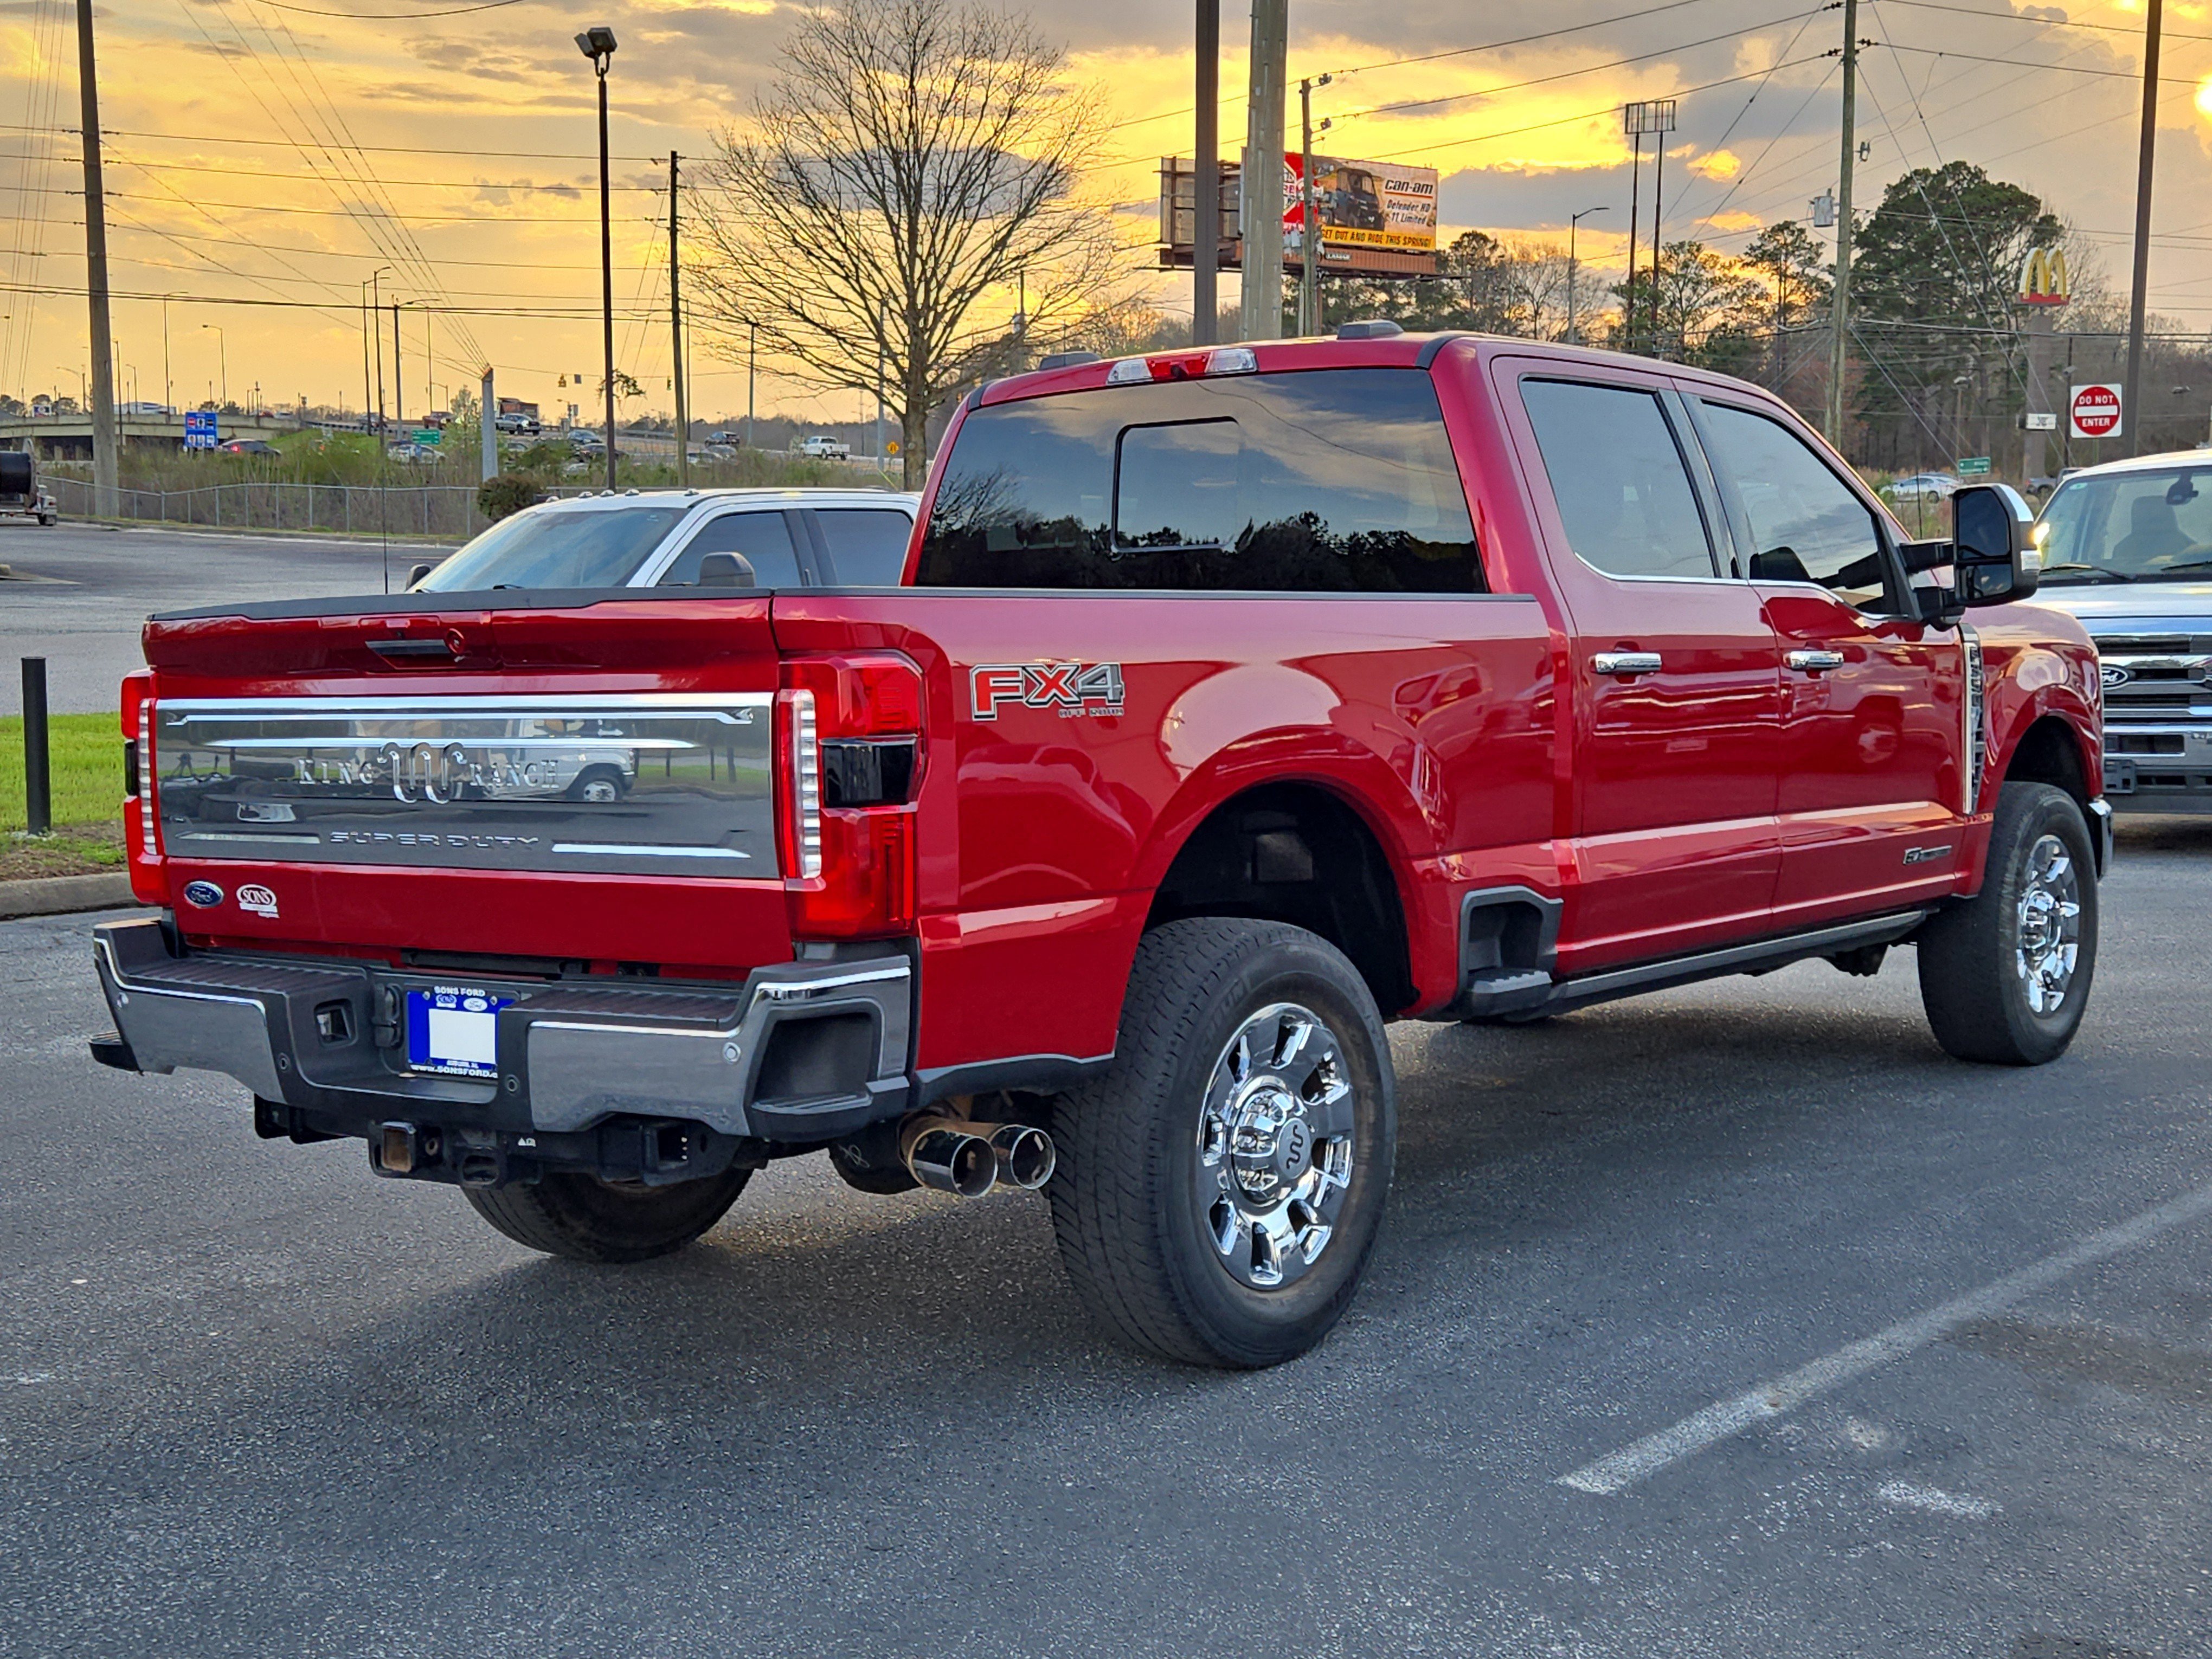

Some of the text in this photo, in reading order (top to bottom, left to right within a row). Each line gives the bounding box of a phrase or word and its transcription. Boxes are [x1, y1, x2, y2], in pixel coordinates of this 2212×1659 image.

[1385, 179, 1433, 194] can-am
[1387, 199, 1419, 211] Defender
[1400, 213, 1427, 224] Limited
[1322, 229, 1431, 248] GET OUT AND RIDE THIS SPRING!
[2079, 395, 2114, 405] DO NOT
[2082, 417, 2110, 427] ENTER
[969, 662, 1125, 721] FX4
[298, 758, 560, 788] KING RANCH
[330, 831, 539, 850] SUPER DUTY
[242, 890, 271, 904] SONS
[434, 986, 486, 997] SONS FORD
